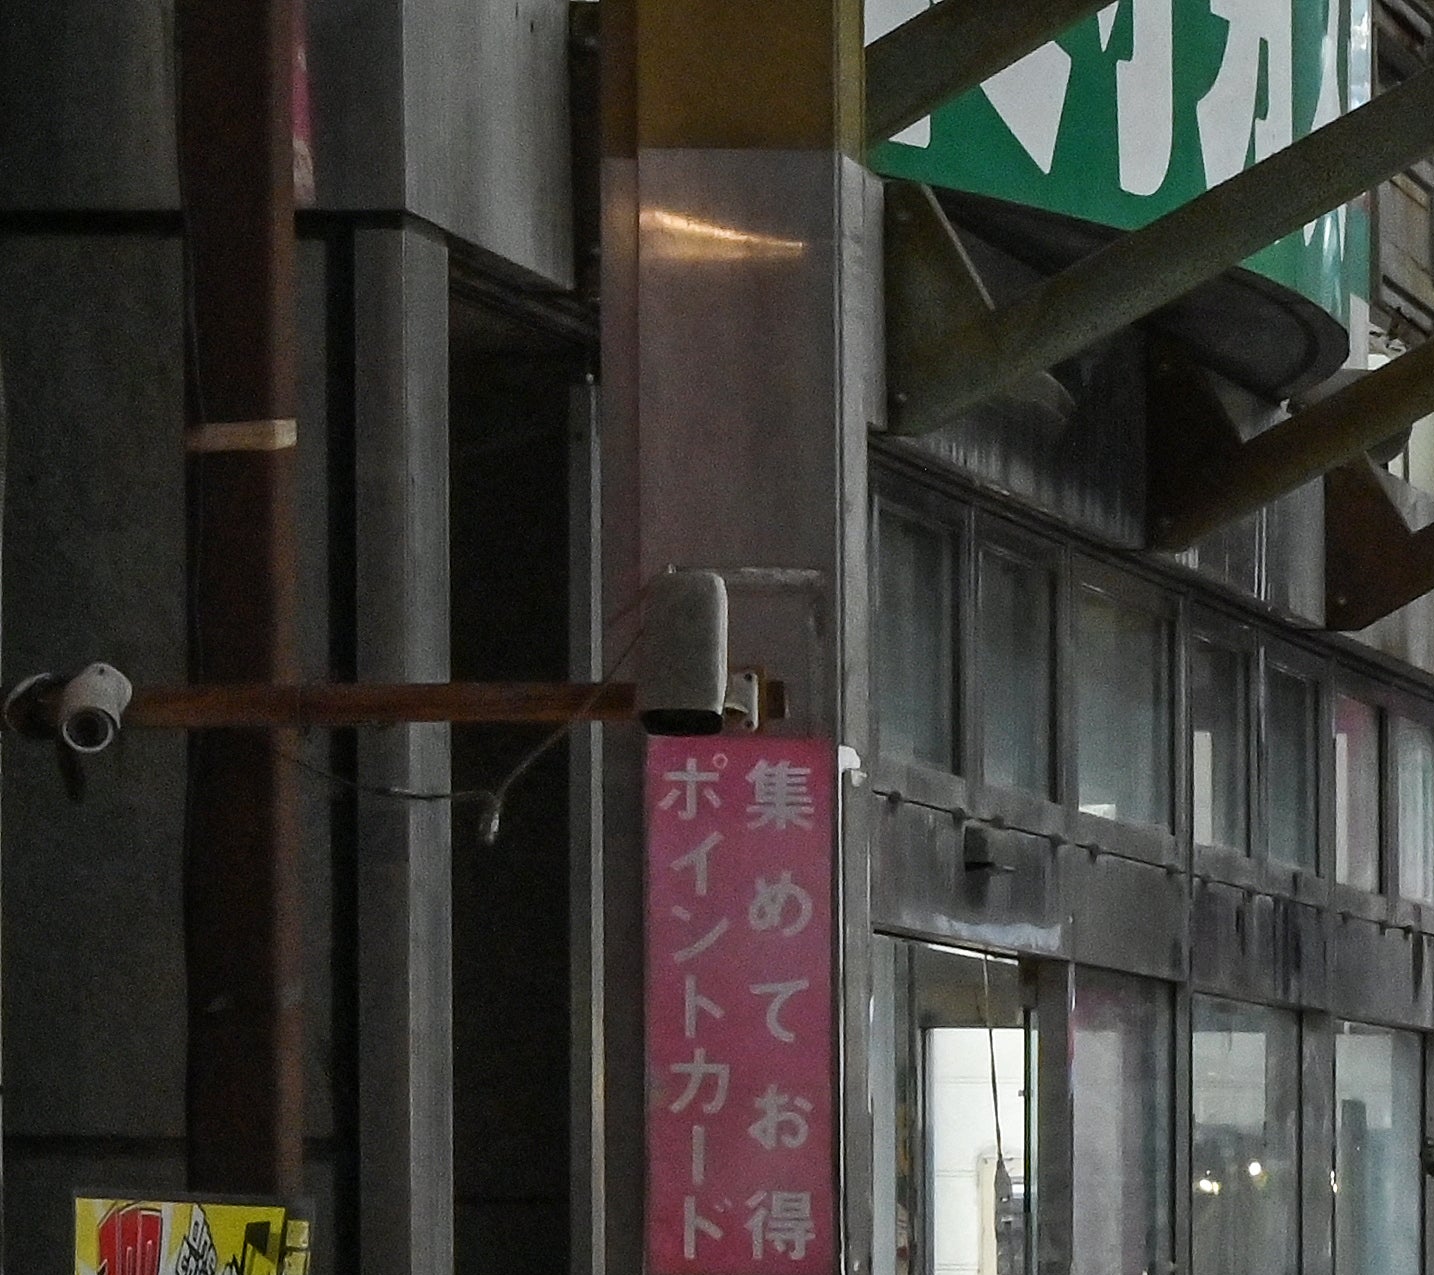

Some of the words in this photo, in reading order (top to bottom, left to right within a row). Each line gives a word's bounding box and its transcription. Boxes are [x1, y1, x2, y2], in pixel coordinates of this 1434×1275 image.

[658, 756, 731, 1261] ポイントカード
[748, 759, 817, 1263] 集めてお得
